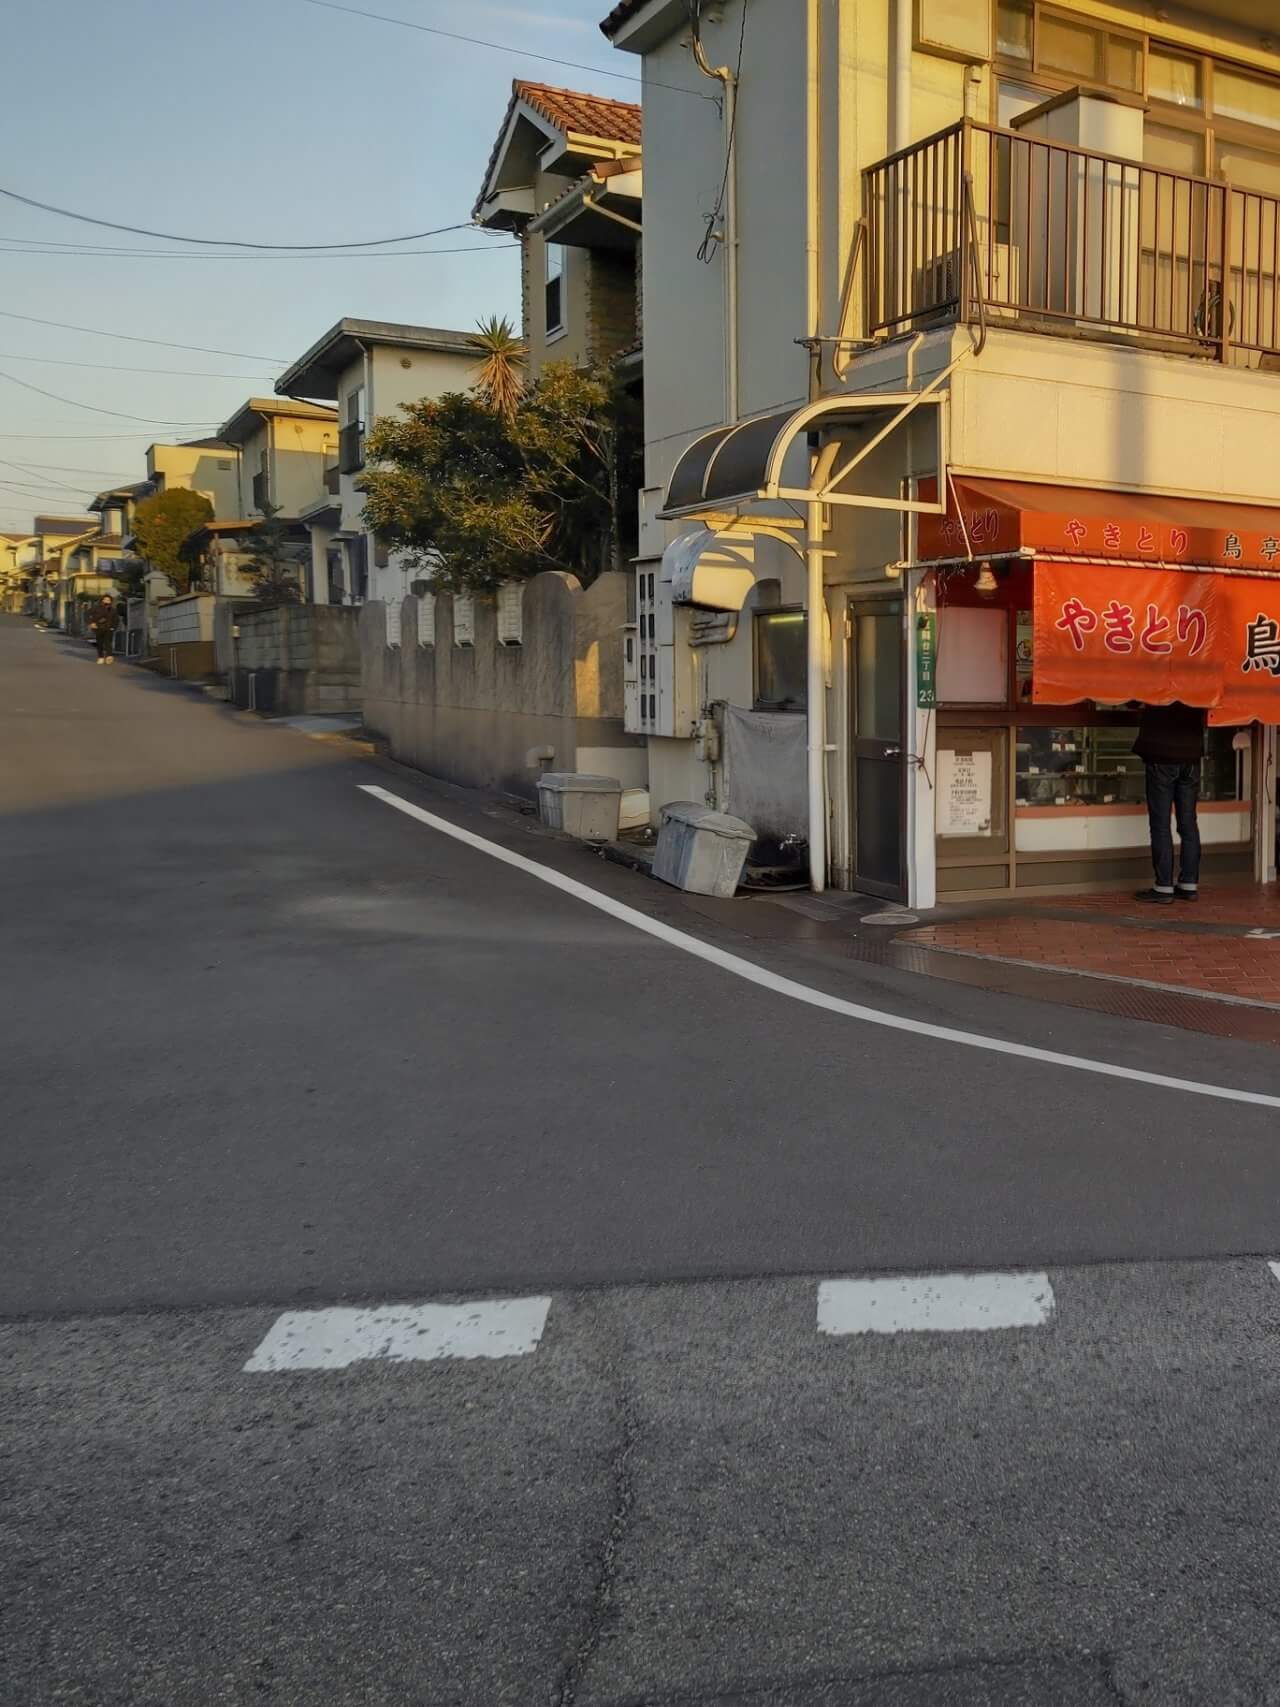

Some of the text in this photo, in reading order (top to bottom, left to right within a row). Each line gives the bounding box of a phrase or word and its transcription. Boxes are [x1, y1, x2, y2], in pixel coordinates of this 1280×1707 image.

[1064, 519, 1188, 556] やきとり
[1223, 531, 1280, 561] 鳥亭
[1056, 597, 1208, 657] やきとり
